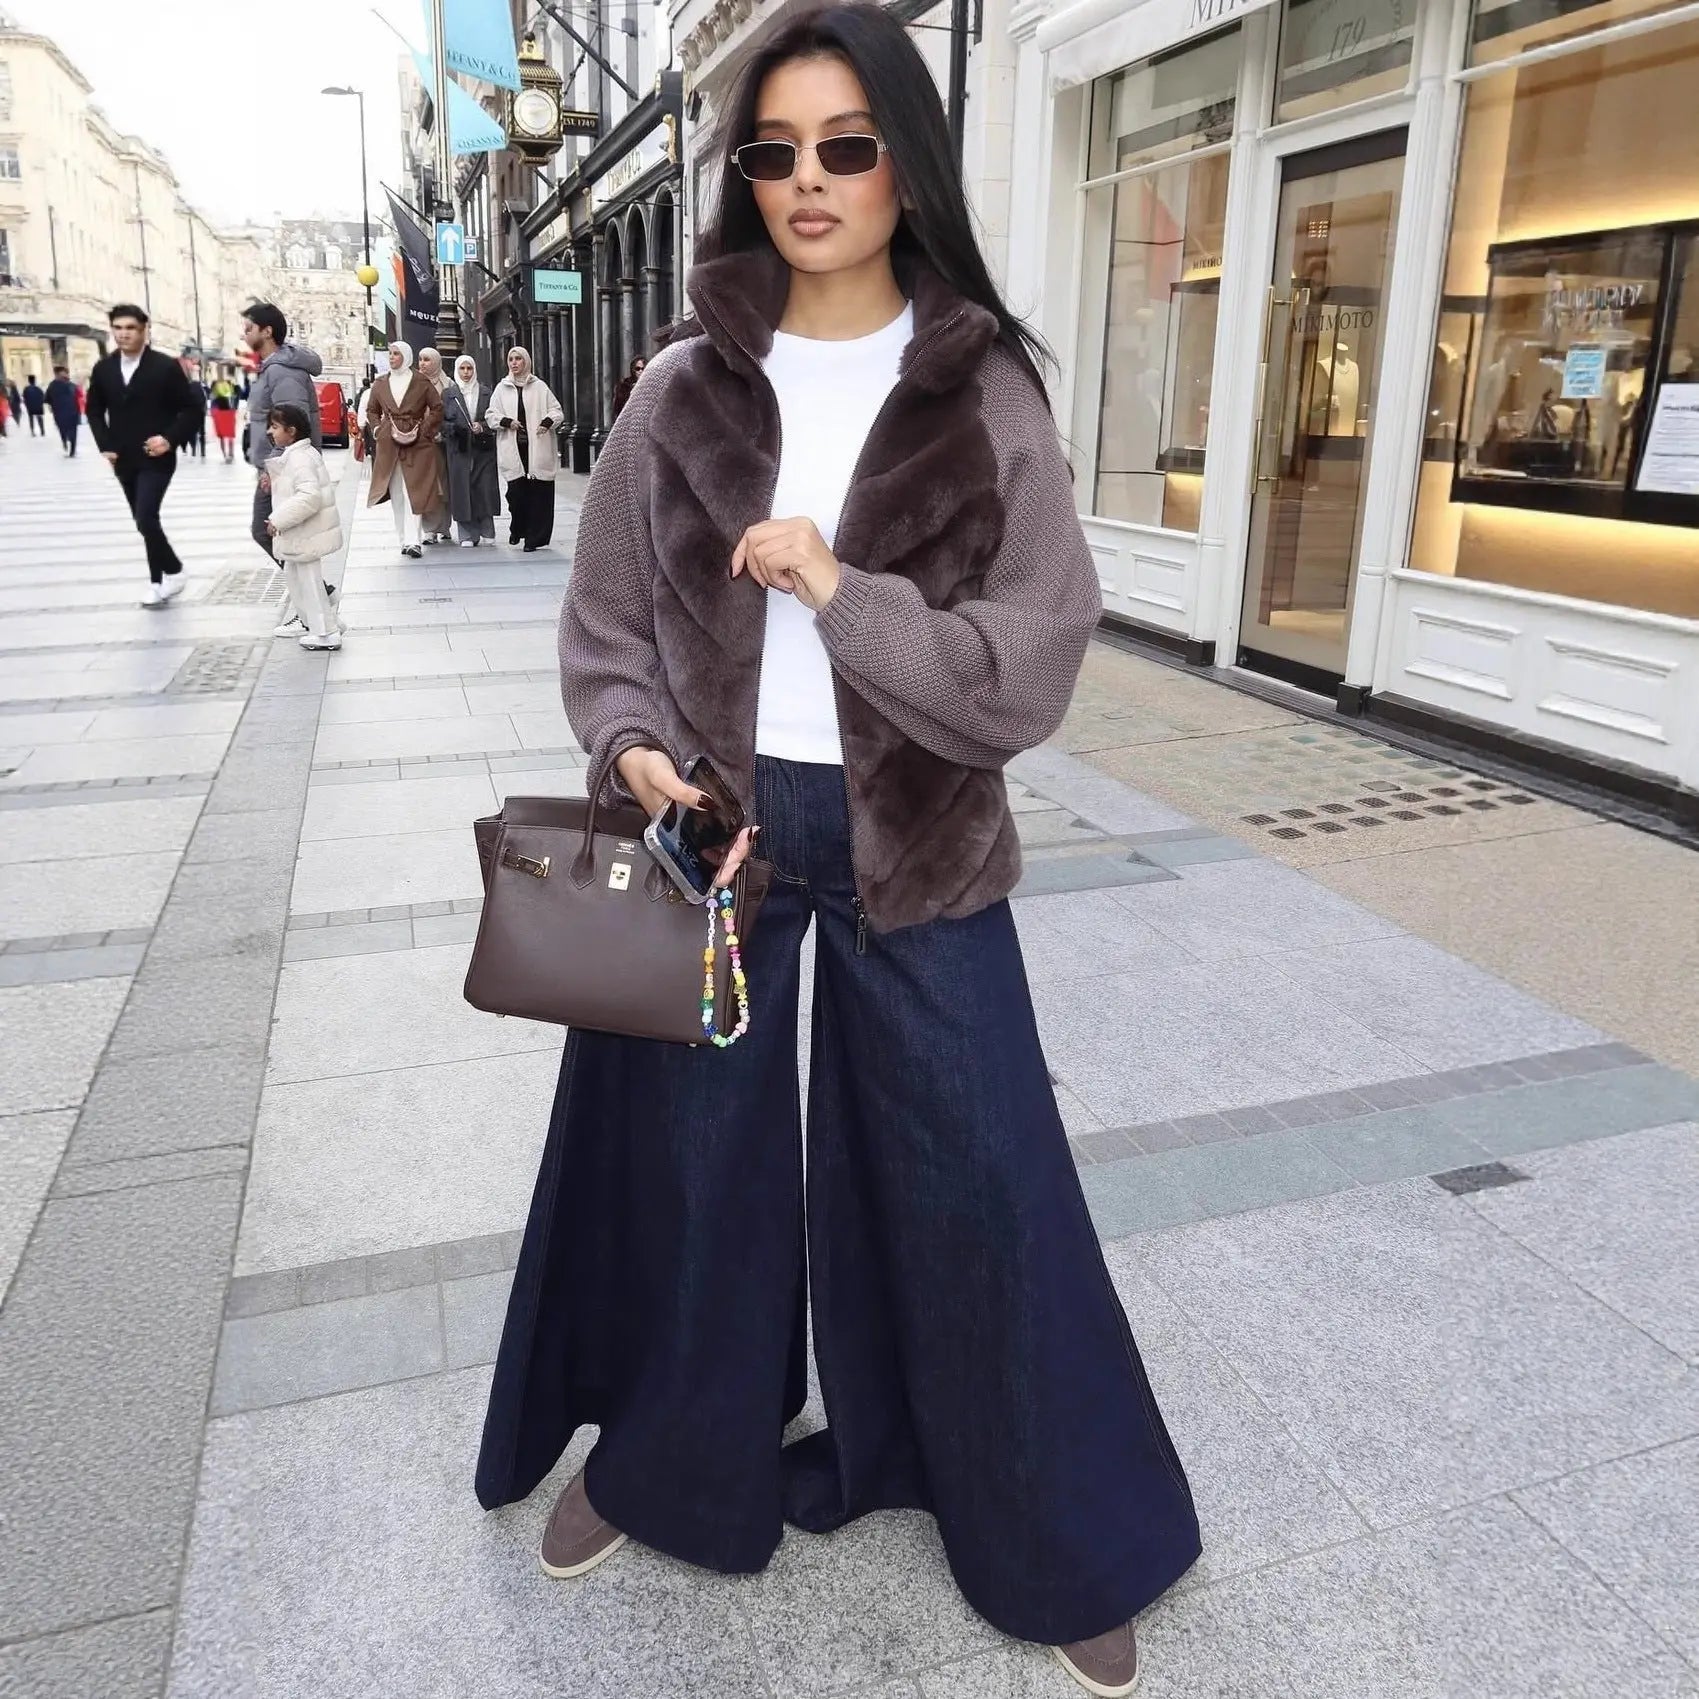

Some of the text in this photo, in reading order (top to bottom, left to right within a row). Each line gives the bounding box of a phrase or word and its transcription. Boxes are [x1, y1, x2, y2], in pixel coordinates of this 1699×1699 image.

[1328, 17, 1367, 62] 179
[577, 118, 597, 129] 1749
[466, 244, 475, 256] P
[538, 282, 563, 291] TIFFANY
[1291, 310, 1374, 334] MIKIMOTO
